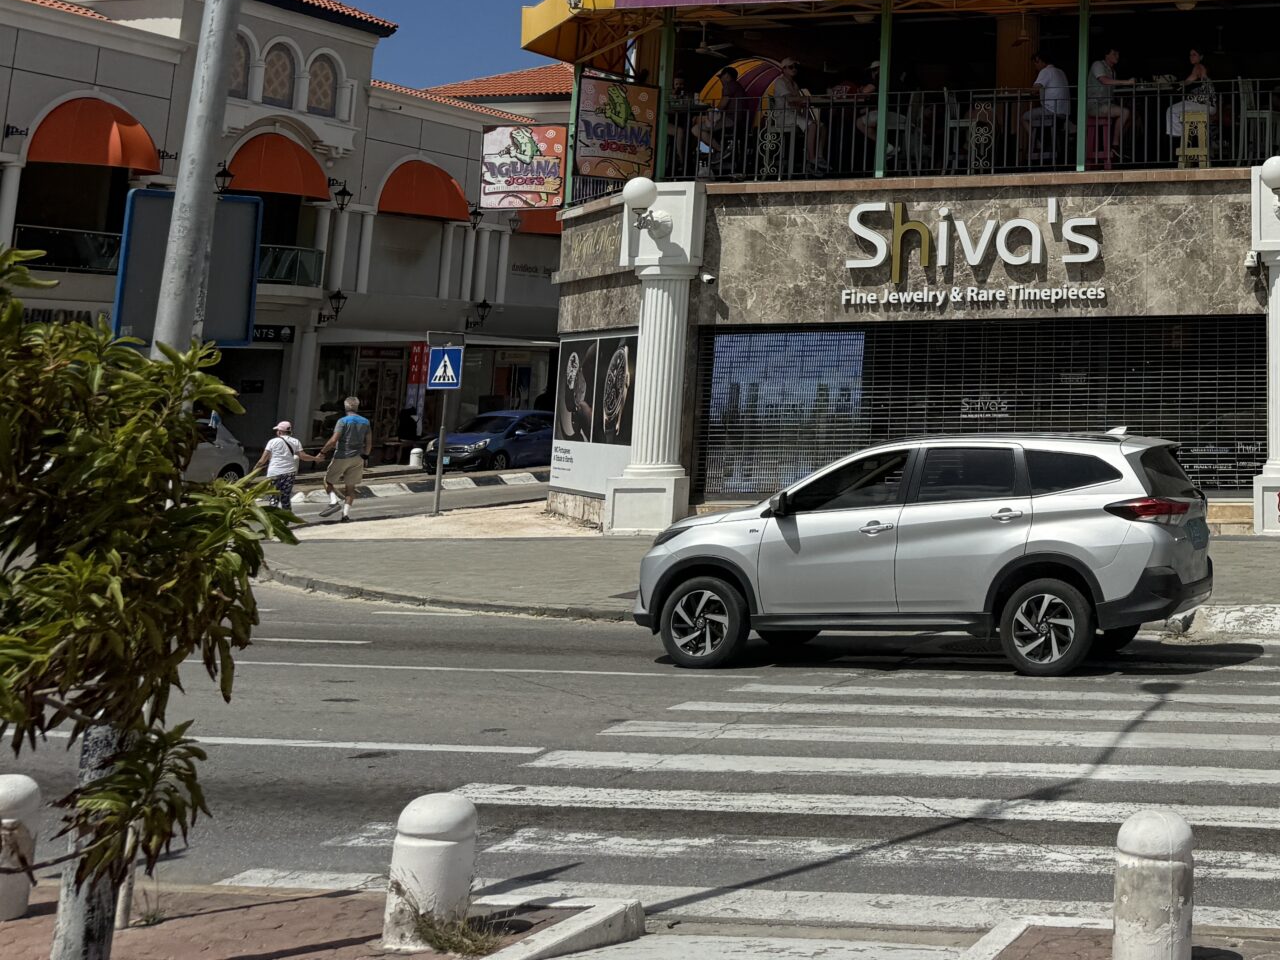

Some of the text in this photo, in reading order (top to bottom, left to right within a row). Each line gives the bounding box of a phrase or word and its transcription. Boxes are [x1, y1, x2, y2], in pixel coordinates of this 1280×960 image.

[581, 119, 651, 145] IGUANA
[483, 159, 561, 178] IGUANA
[845, 198, 1101, 284] Shiva's
[841, 284, 1106, 306] Fine Jewelry & Rare Timepieces
